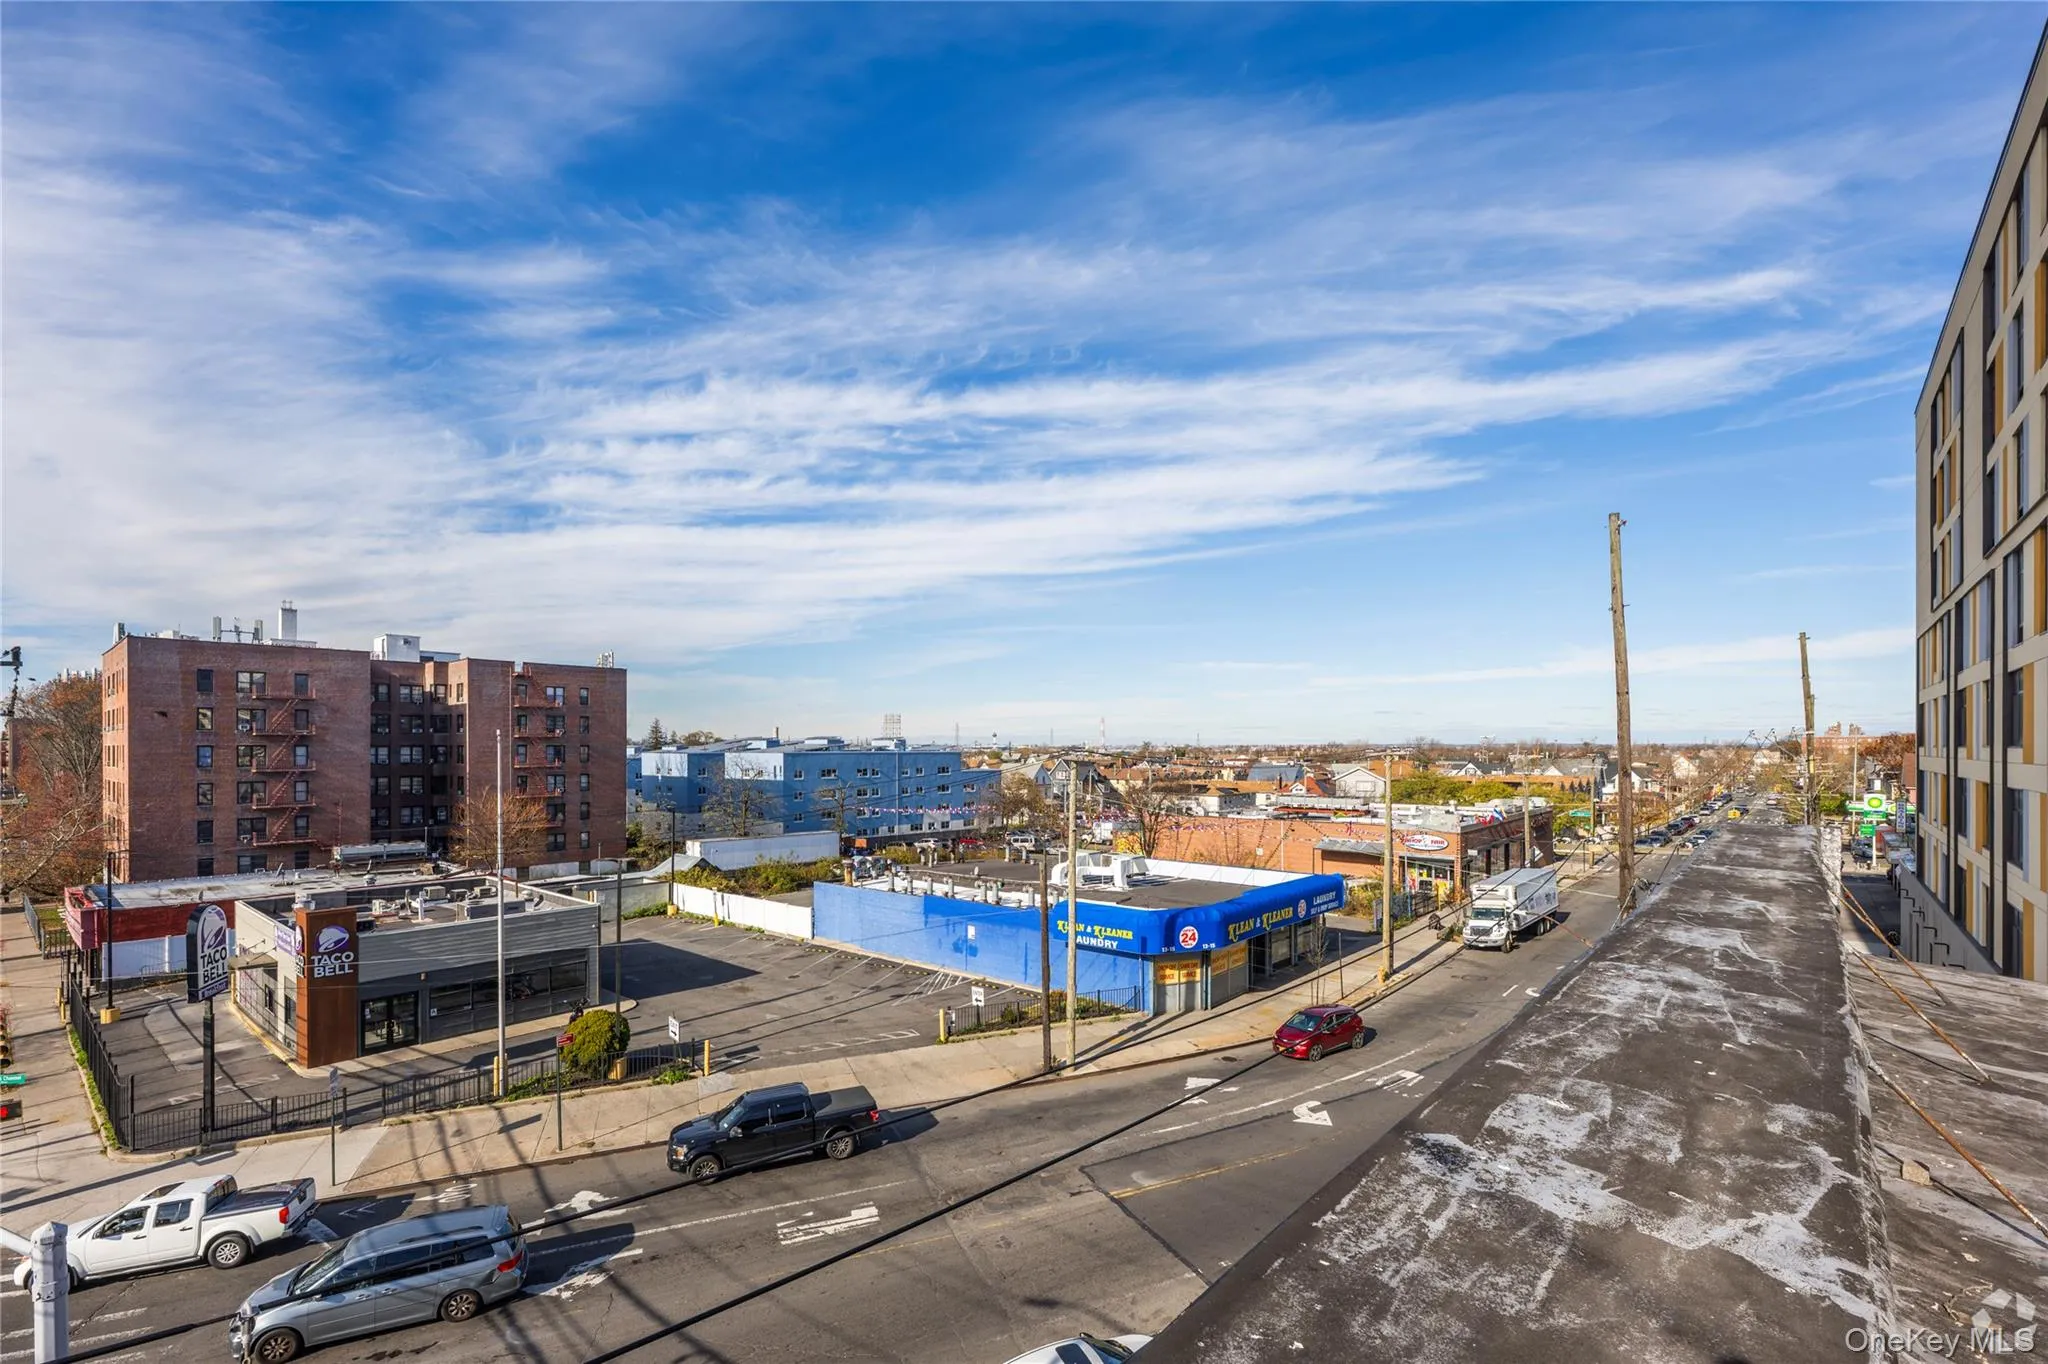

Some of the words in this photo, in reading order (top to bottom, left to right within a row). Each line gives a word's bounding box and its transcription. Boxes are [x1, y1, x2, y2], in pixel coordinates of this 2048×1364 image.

[1228, 918, 1254, 942] KLEAN
[1255, 917, 1261, 928] &
[1262, 907, 1293, 931] KLEANER
[1086, 925, 1092, 933] &
[1093, 925, 1133, 940] KLEANER
[1181, 932, 1197, 944] 24
[1076, 935, 1118, 949] AUNDRY
[200, 946, 228, 969] TACO
[311, 951, 354, 967] TACO
[203, 961, 228, 985] BELL
[313, 963, 354, 978] BELL
